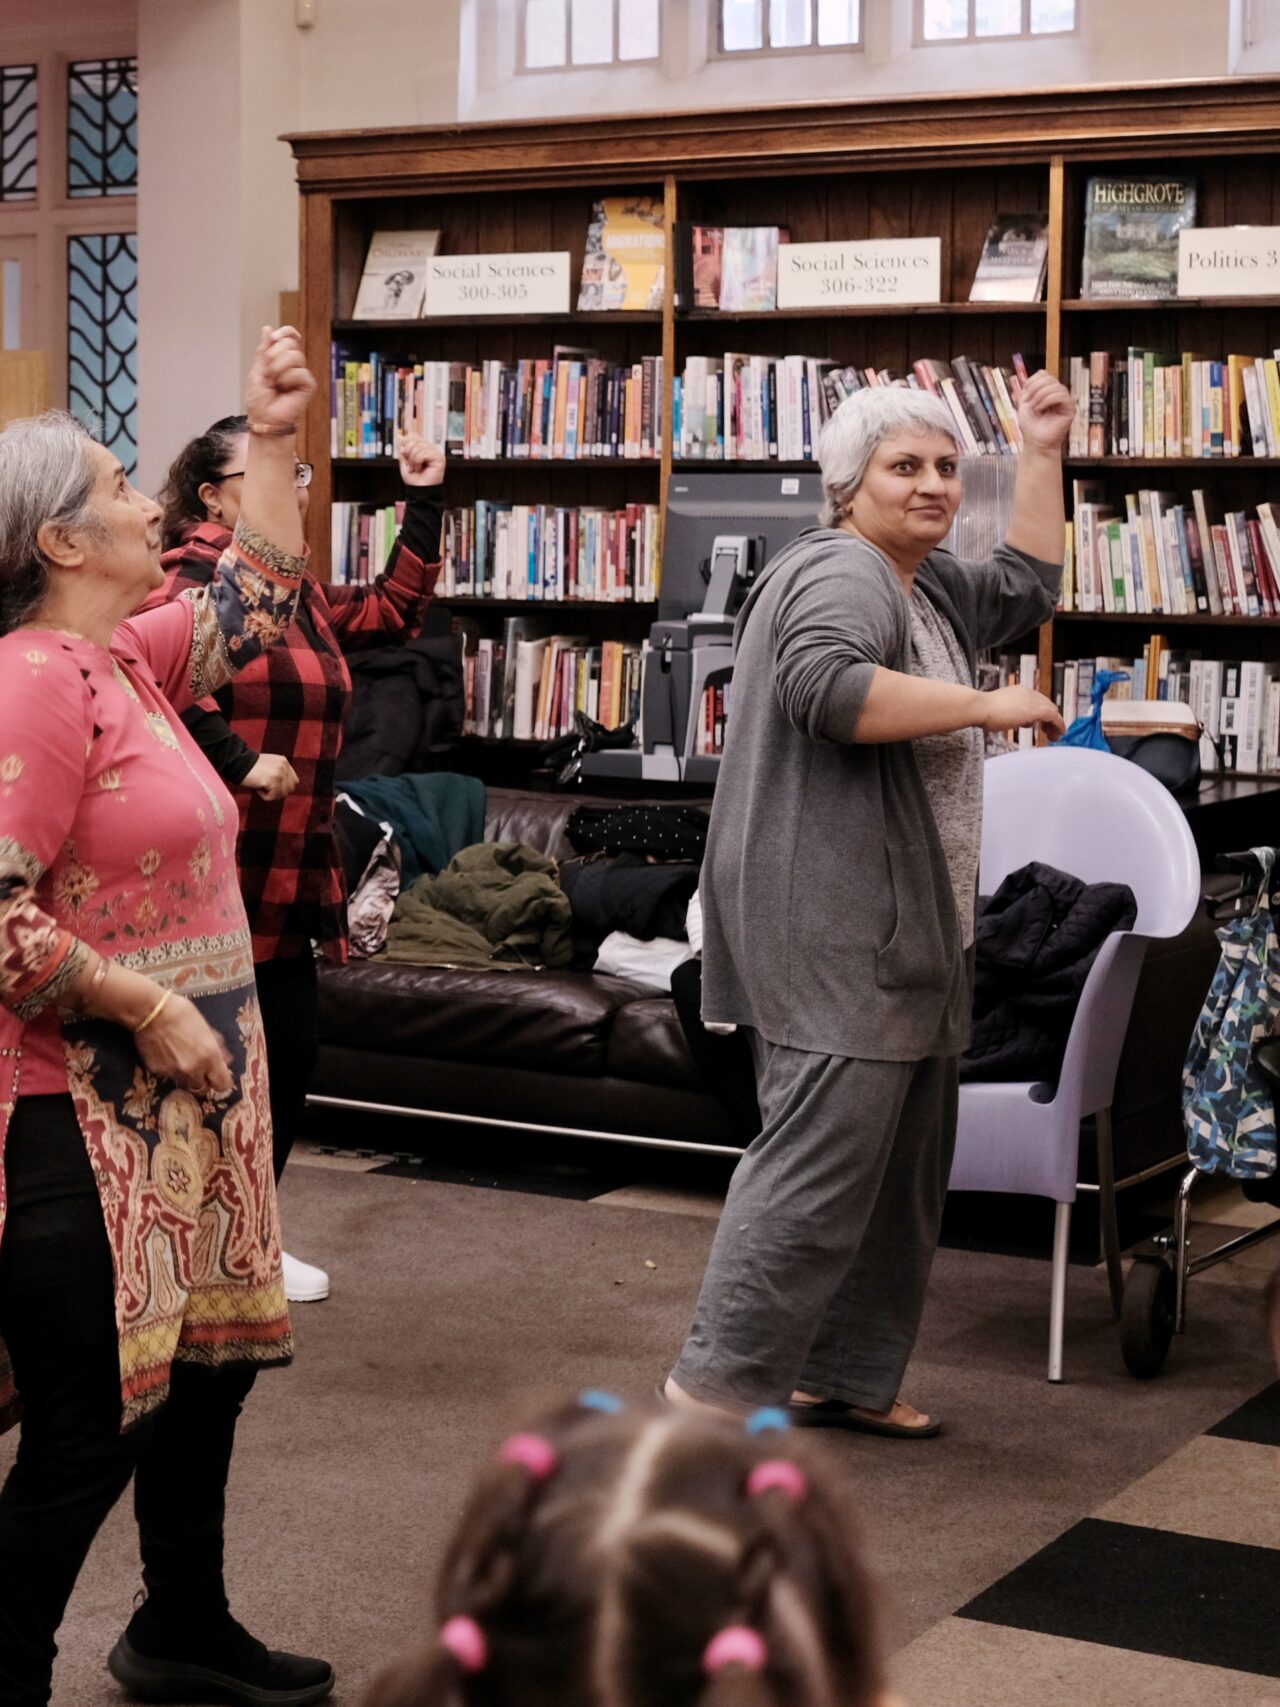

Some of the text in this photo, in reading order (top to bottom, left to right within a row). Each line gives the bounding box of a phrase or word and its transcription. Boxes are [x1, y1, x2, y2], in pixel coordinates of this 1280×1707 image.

[1094, 183, 1185, 203] HIGHGROVE
[791, 252, 930, 272] Social Sciences
[1188, 250, 1278, 269] Politics 3
[432, 261, 556, 281] Social Sciences
[458, 284, 528, 301] 300-305
[820, 276, 898, 295] 306-322
